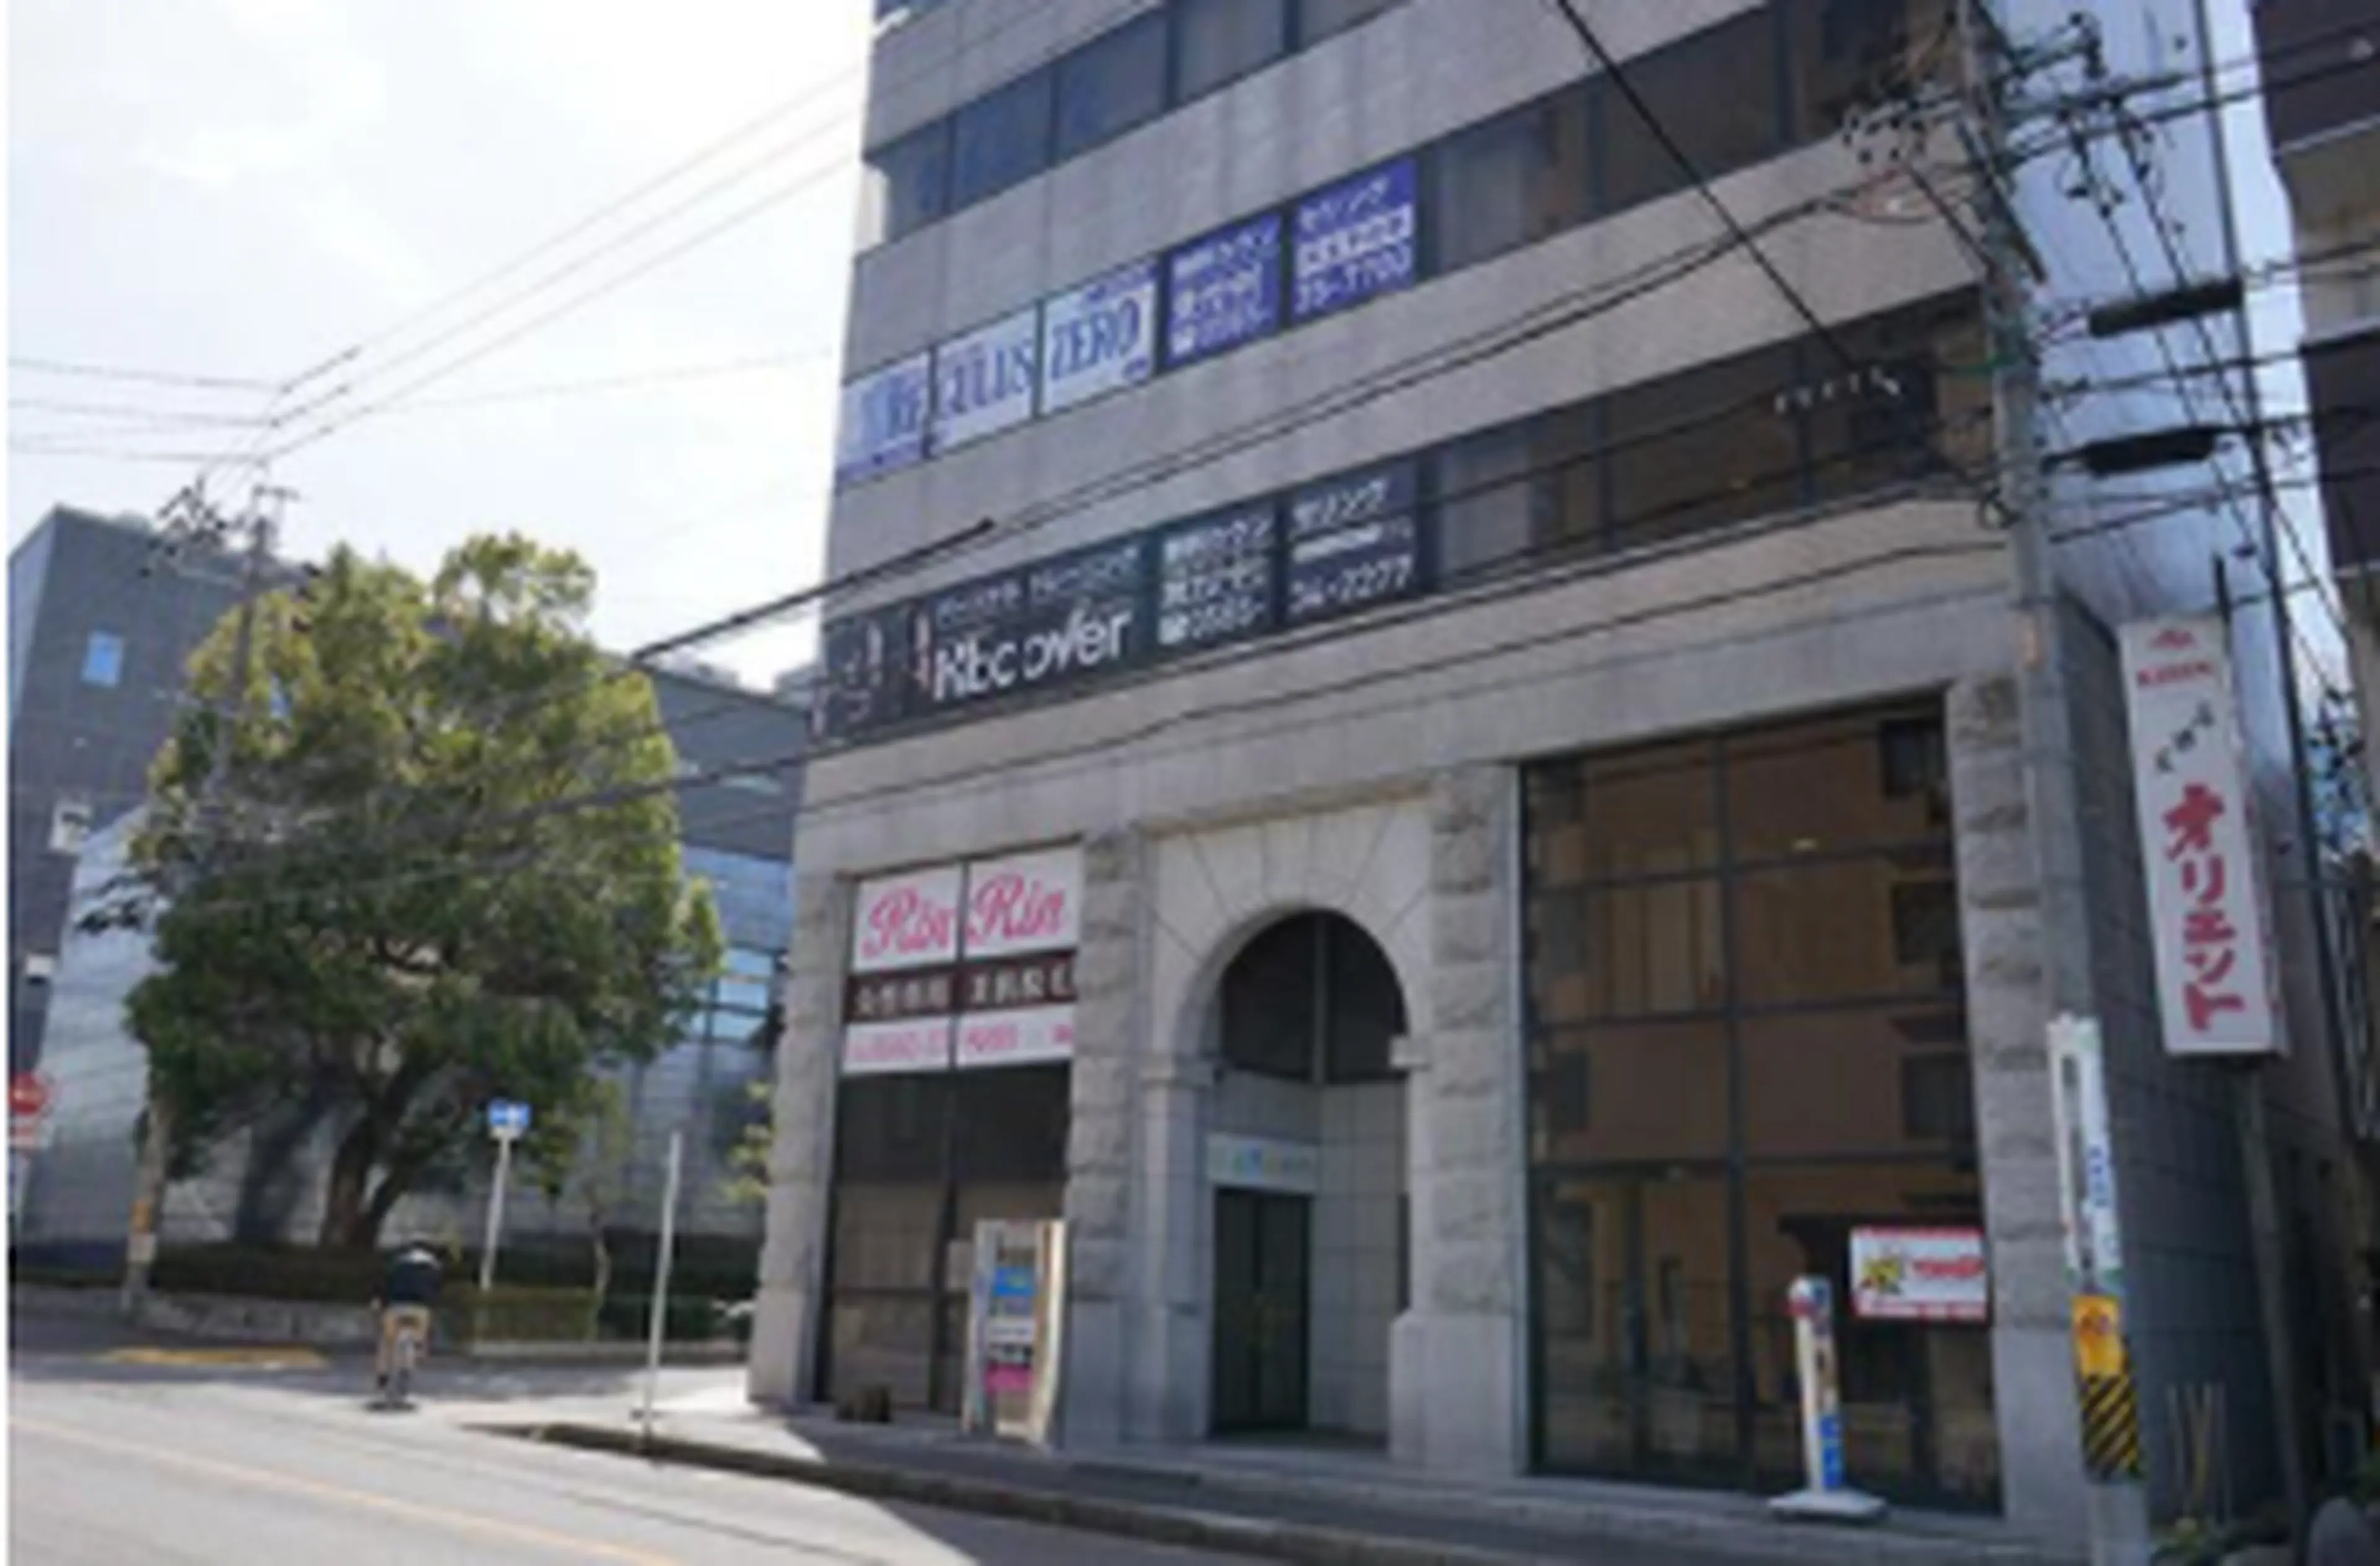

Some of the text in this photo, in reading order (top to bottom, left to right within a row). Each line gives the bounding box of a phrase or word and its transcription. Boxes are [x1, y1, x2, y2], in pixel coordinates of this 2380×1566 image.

[964, 871, 1066, 946] Rin
[2164, 781, 2245, 1033] オリエント
